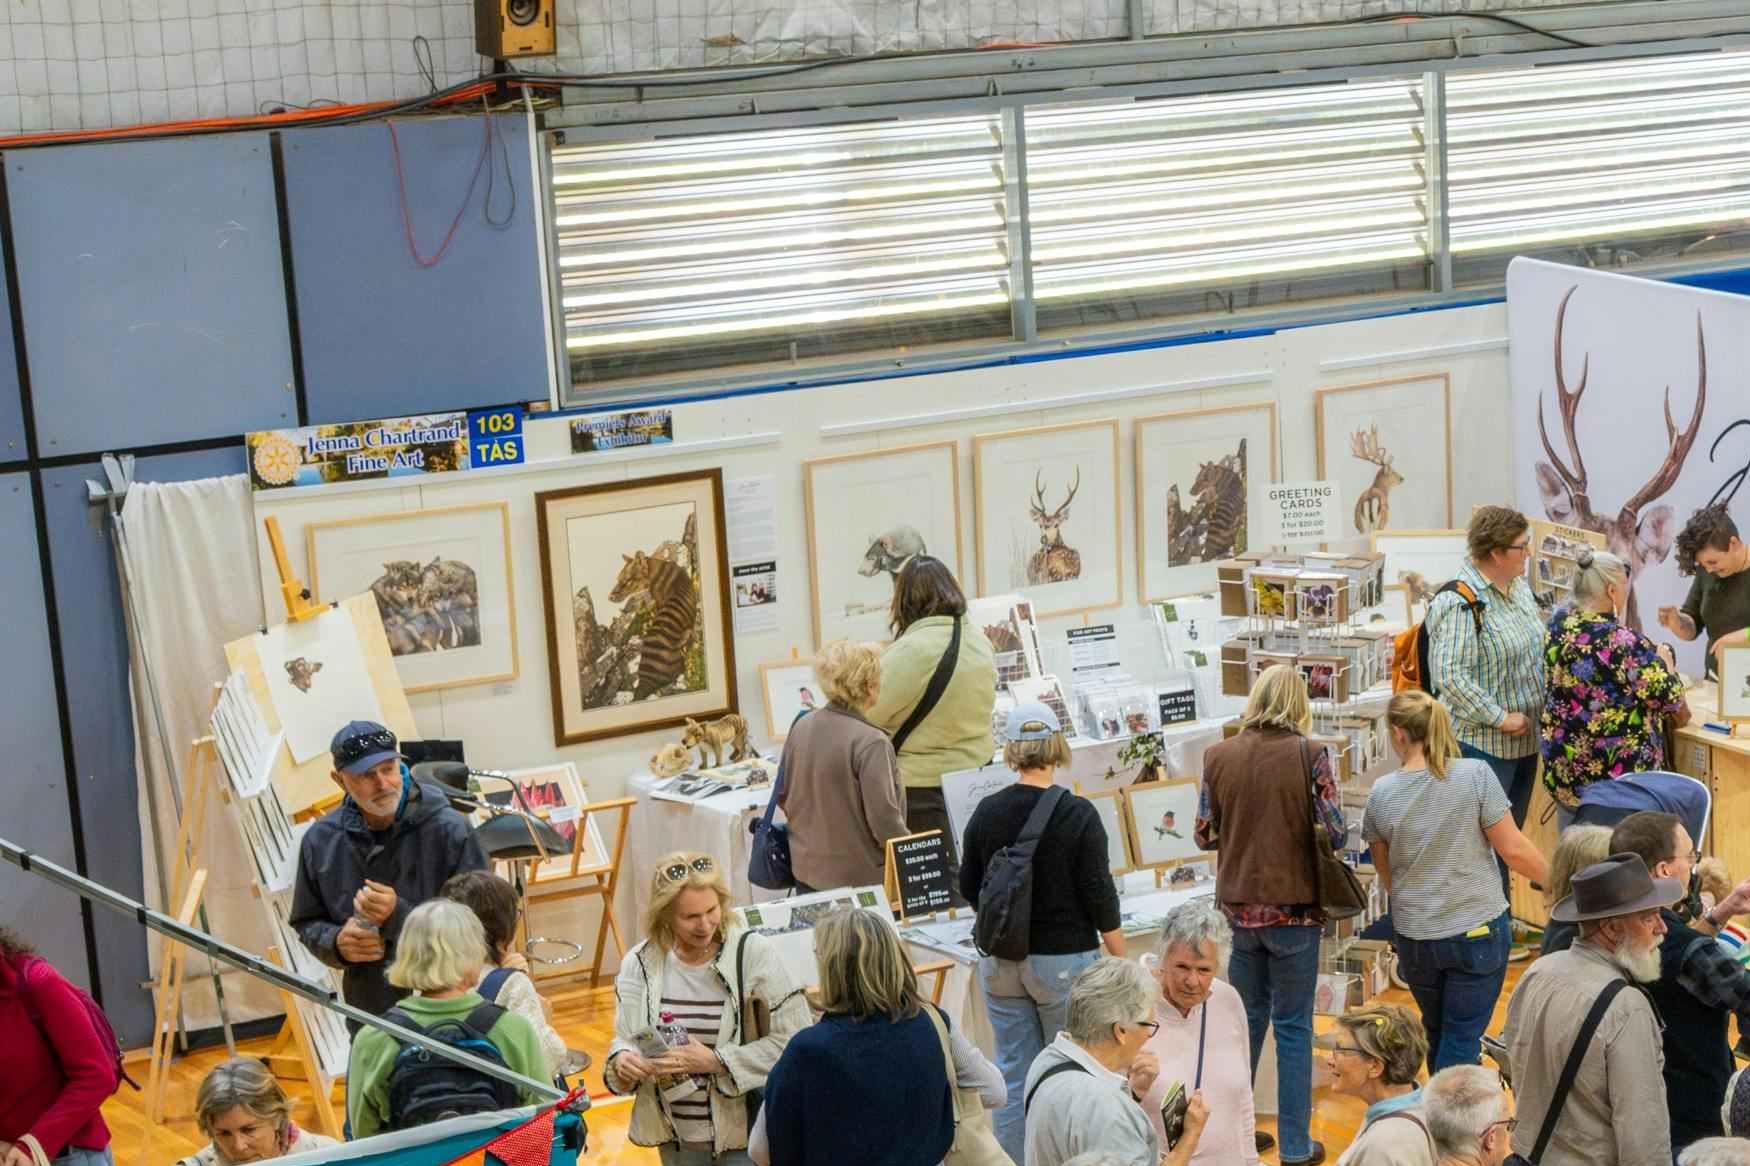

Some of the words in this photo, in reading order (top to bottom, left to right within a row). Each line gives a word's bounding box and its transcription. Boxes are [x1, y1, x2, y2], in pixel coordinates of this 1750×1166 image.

[476, 412, 516, 435] 103
[307, 434, 360, 455] Jenna
[365, 422, 461, 448] Chartrand
[477, 439, 518, 462] TAS
[347, 451, 390, 474] Fine
[392, 450, 425, 470] Art
[1269, 487, 1332, 500] GREETING
[1280, 498, 1322, 510] CARDS
[1160, 697, 1175, 706] GIFT
[1177, 695, 1194, 704] TAGS
[898, 838, 942, 853] CALENDARS
[912, 873, 921, 881] for
